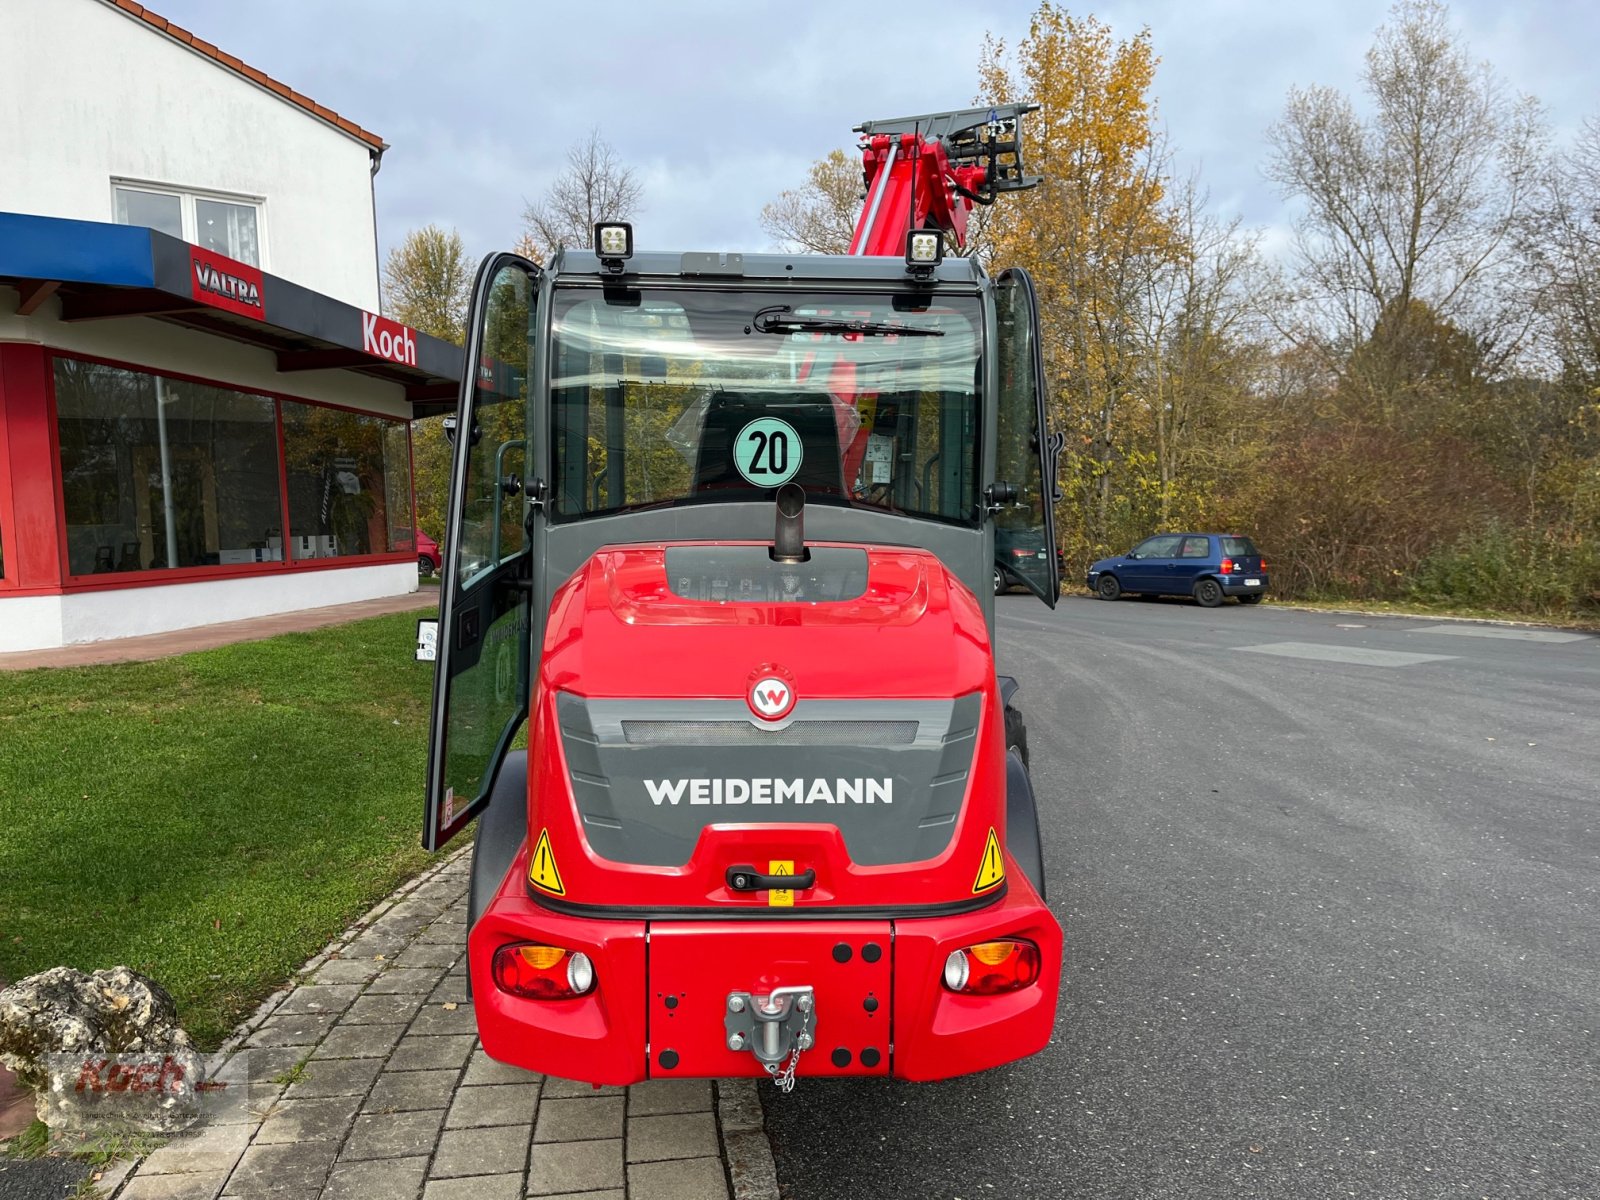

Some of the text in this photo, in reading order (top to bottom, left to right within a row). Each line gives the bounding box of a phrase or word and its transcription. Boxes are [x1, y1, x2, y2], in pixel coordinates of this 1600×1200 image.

[193, 258, 261, 308] VALTRA
[362, 311, 416, 366] Koch
[748, 430, 788, 475] 20
[643, 778, 893, 805] WEIDEMANN
